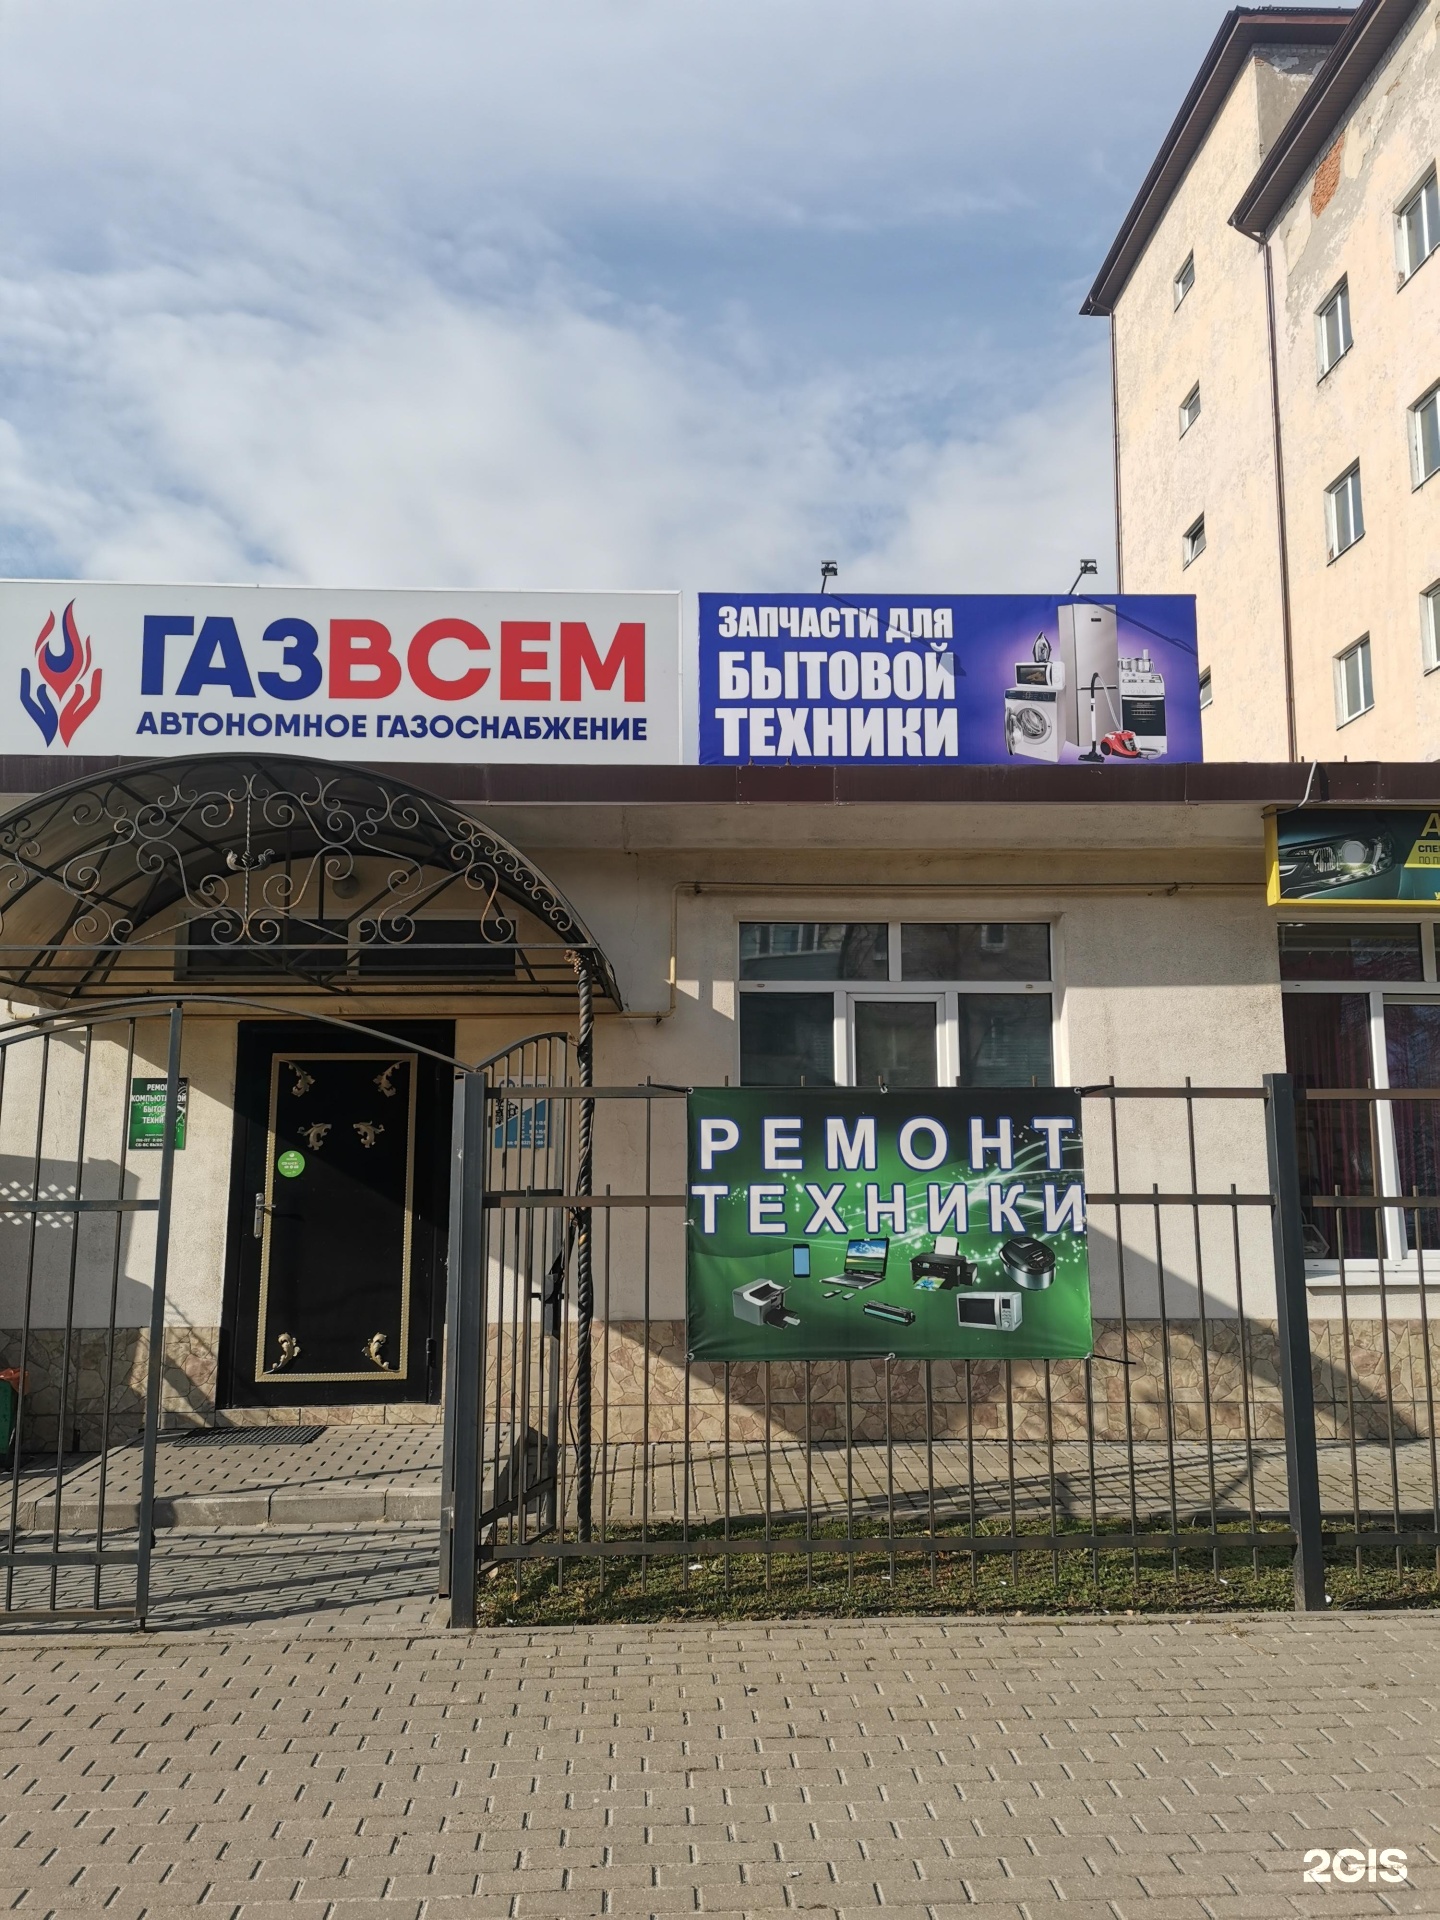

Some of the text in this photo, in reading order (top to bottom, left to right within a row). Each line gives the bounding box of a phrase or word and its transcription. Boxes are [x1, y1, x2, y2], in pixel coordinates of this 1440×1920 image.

[718, 605, 954, 643] ЗАПЧАСТИ ДЛЯ
[140, 614, 646, 703] ГАЗВСЕМ
[718, 641, 956, 700] БЫТОВОЙ
[136, 711, 648, 742] АВТОНОМНОЕ ГАЗОСНАБЖЕНИЕ
[714, 706, 959, 758] ТЕХНИКИ
[1418, 844, 1440, 853] СПЕ
[698, 1116, 1075, 1172] РЕМОНТ
[690, 1182, 1086, 1235] ТЕХНИКИ
